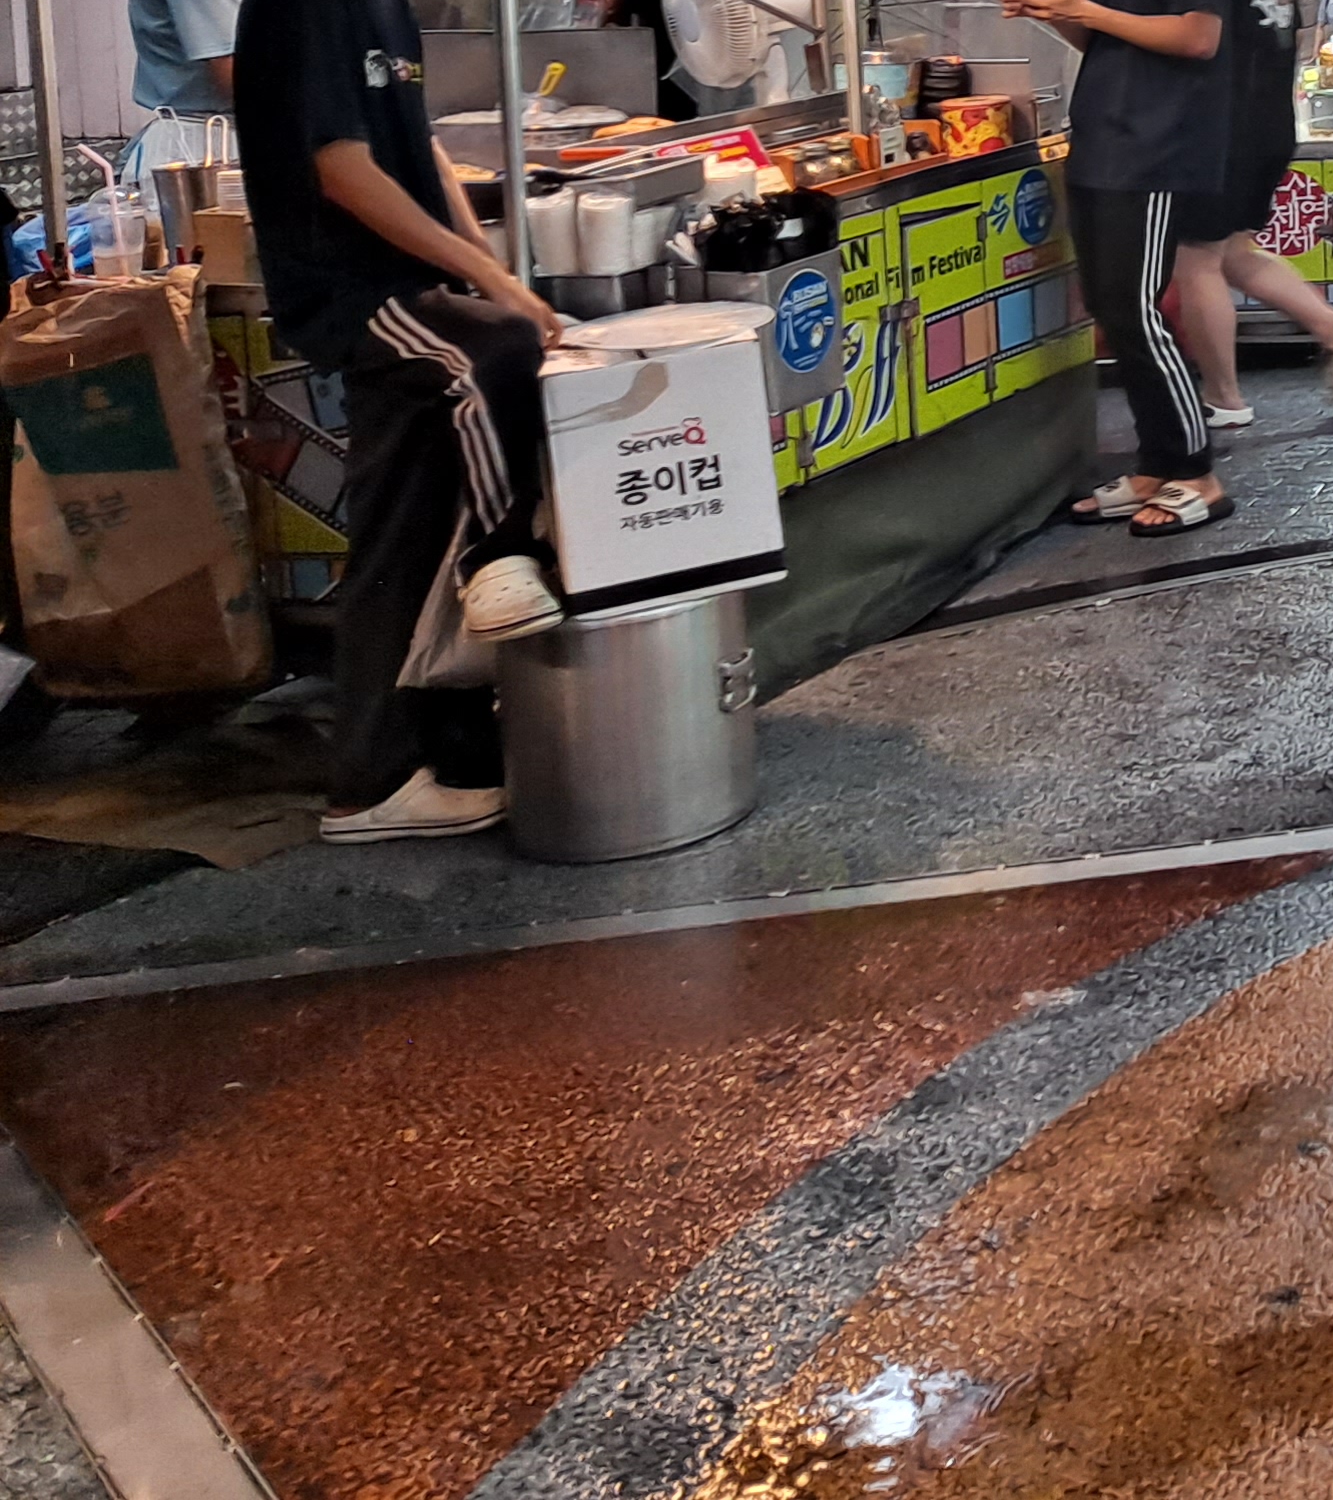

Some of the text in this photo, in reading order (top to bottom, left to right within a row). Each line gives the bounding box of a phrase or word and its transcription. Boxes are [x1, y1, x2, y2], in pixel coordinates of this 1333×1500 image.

[929, 241, 987, 280] Festival
[615, 454, 723, 506] 종이컵
[619, 498, 726, 531] 자동판매기용
